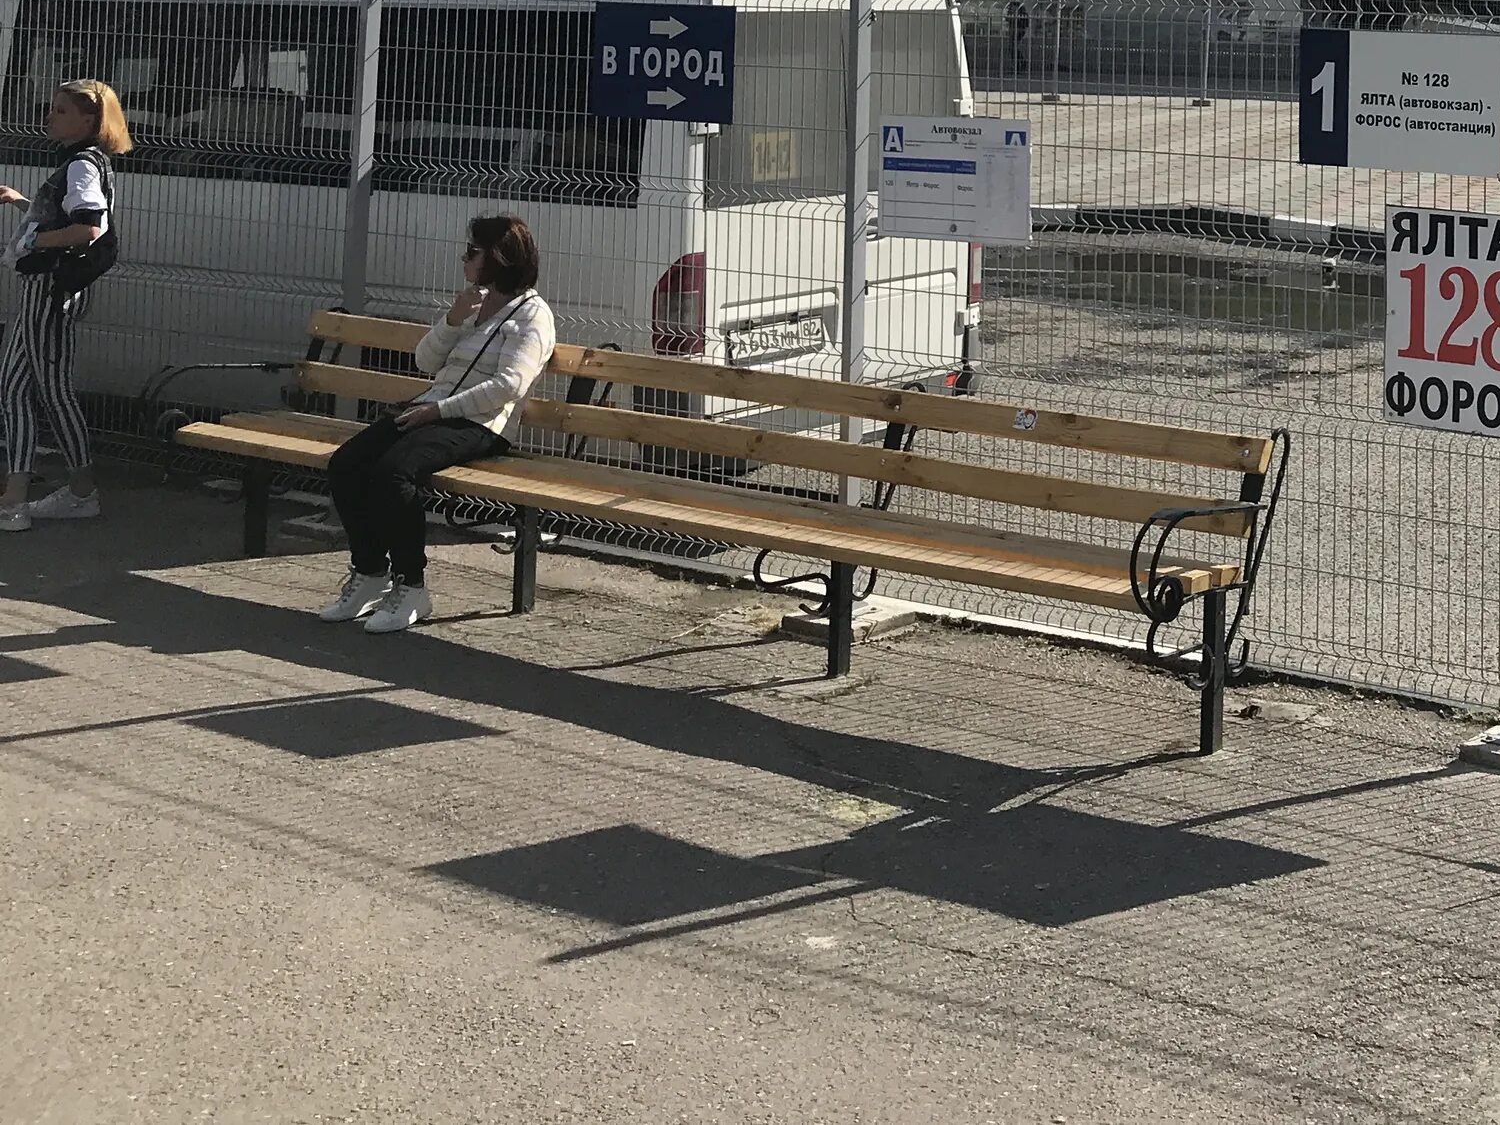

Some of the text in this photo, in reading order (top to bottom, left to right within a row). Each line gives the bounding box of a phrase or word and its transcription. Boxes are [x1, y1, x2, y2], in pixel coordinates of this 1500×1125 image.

[602, 45, 724, 87] В ГОРОД
[1401, 71, 1450, 88] № 128
[1311, 61, 1336, 133] 1
[1360, 92, 1396, 107] ЯЛТА
[1399, 95, 1483, 115] (автовокзал)
[931, 124, 982, 136] Автовокзал
[1355, 113, 1496, 137] ФОРОС (автостанция)
[884, 127, 903, 152] А
